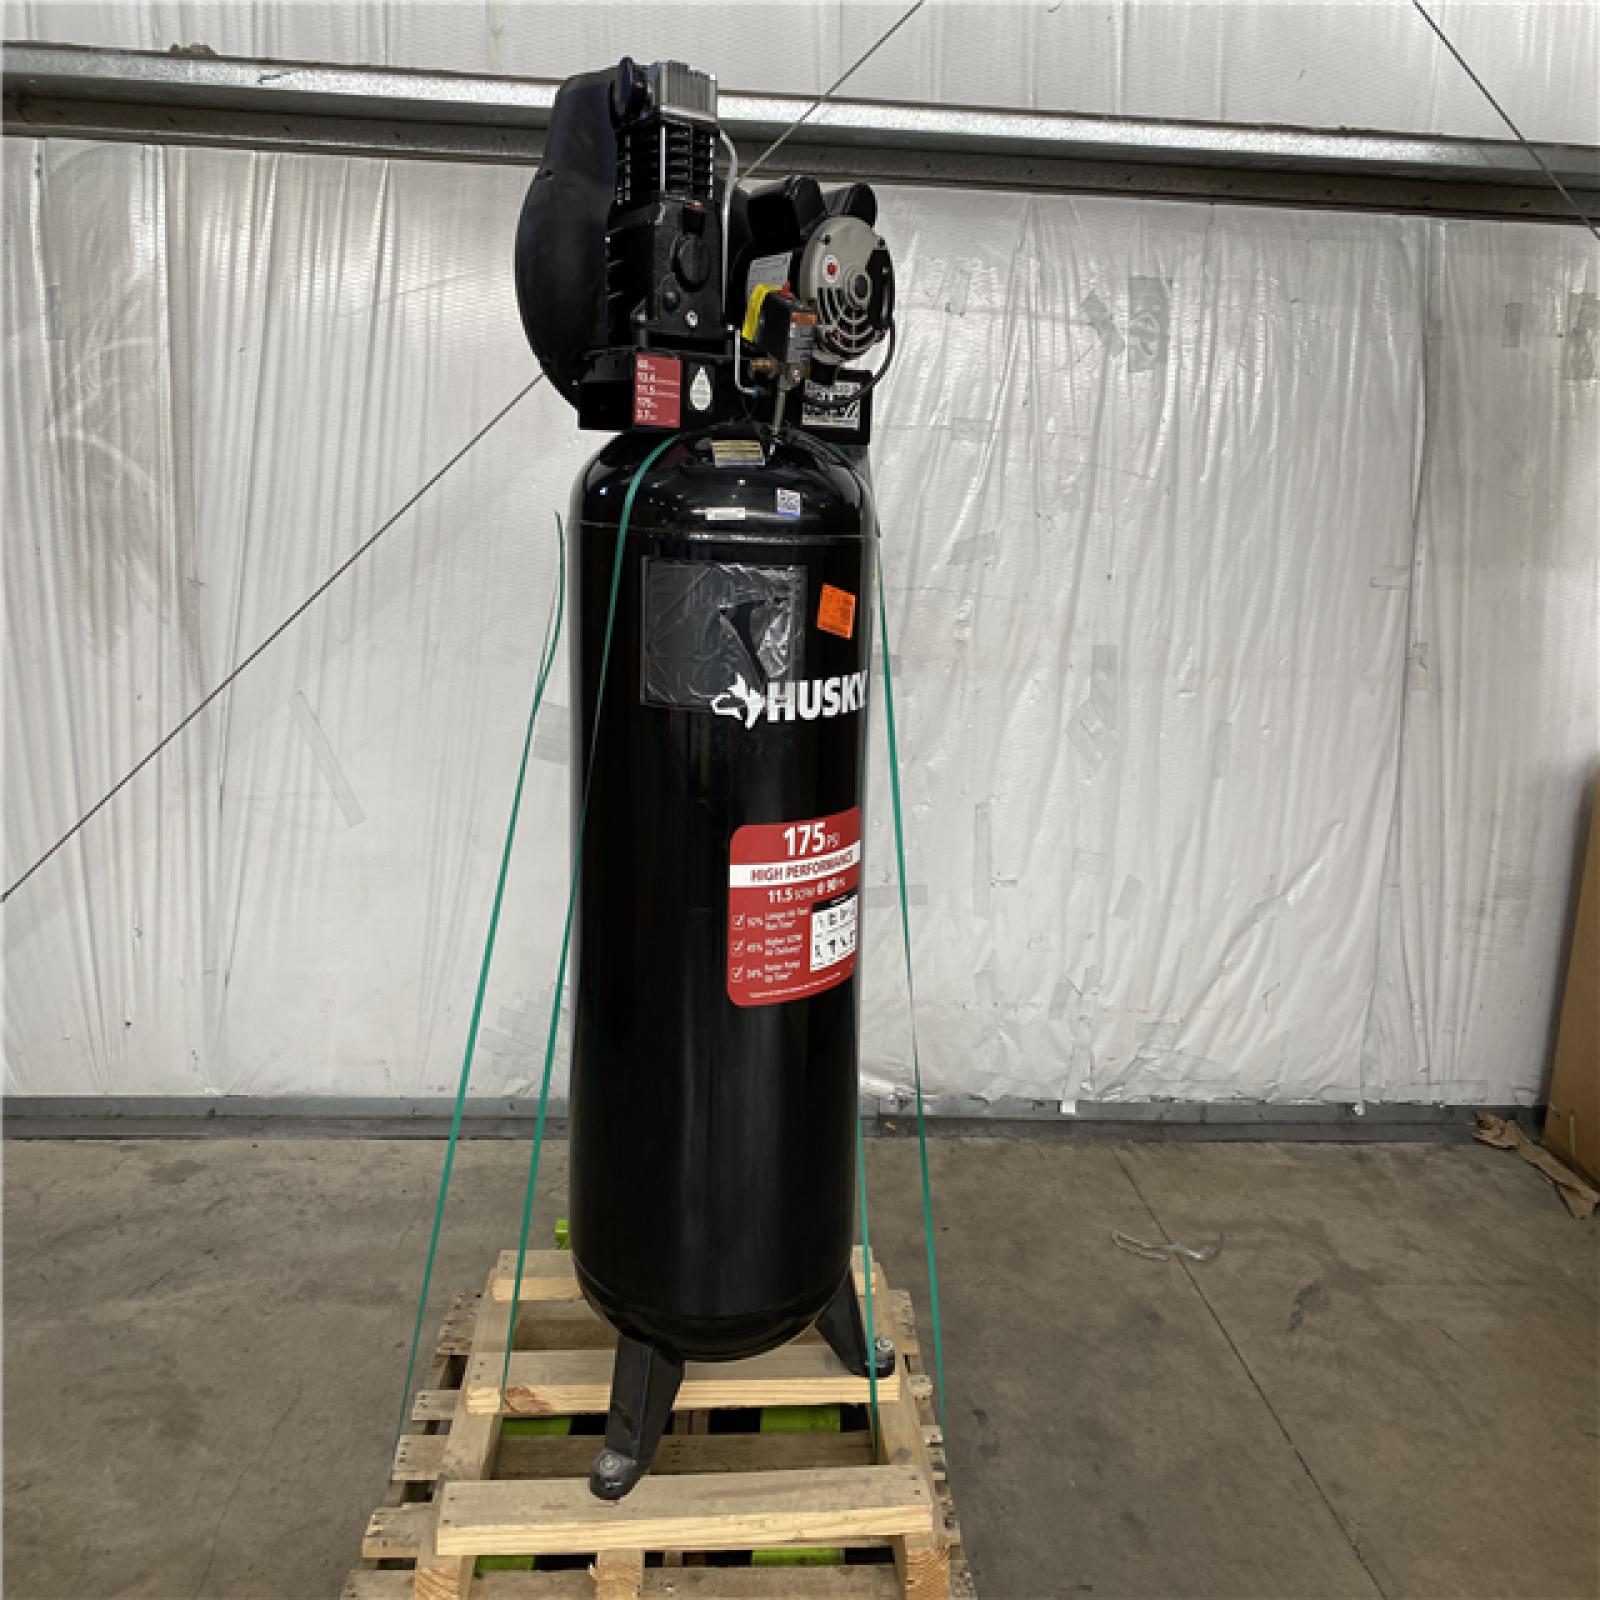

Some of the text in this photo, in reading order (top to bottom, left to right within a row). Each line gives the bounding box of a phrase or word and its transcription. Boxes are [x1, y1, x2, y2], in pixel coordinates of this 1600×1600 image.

[783, 821, 825, 857] 175
[750, 848, 853, 882] HIGH PERFORMANCE
[767, 887, 793, 904] 11.5
